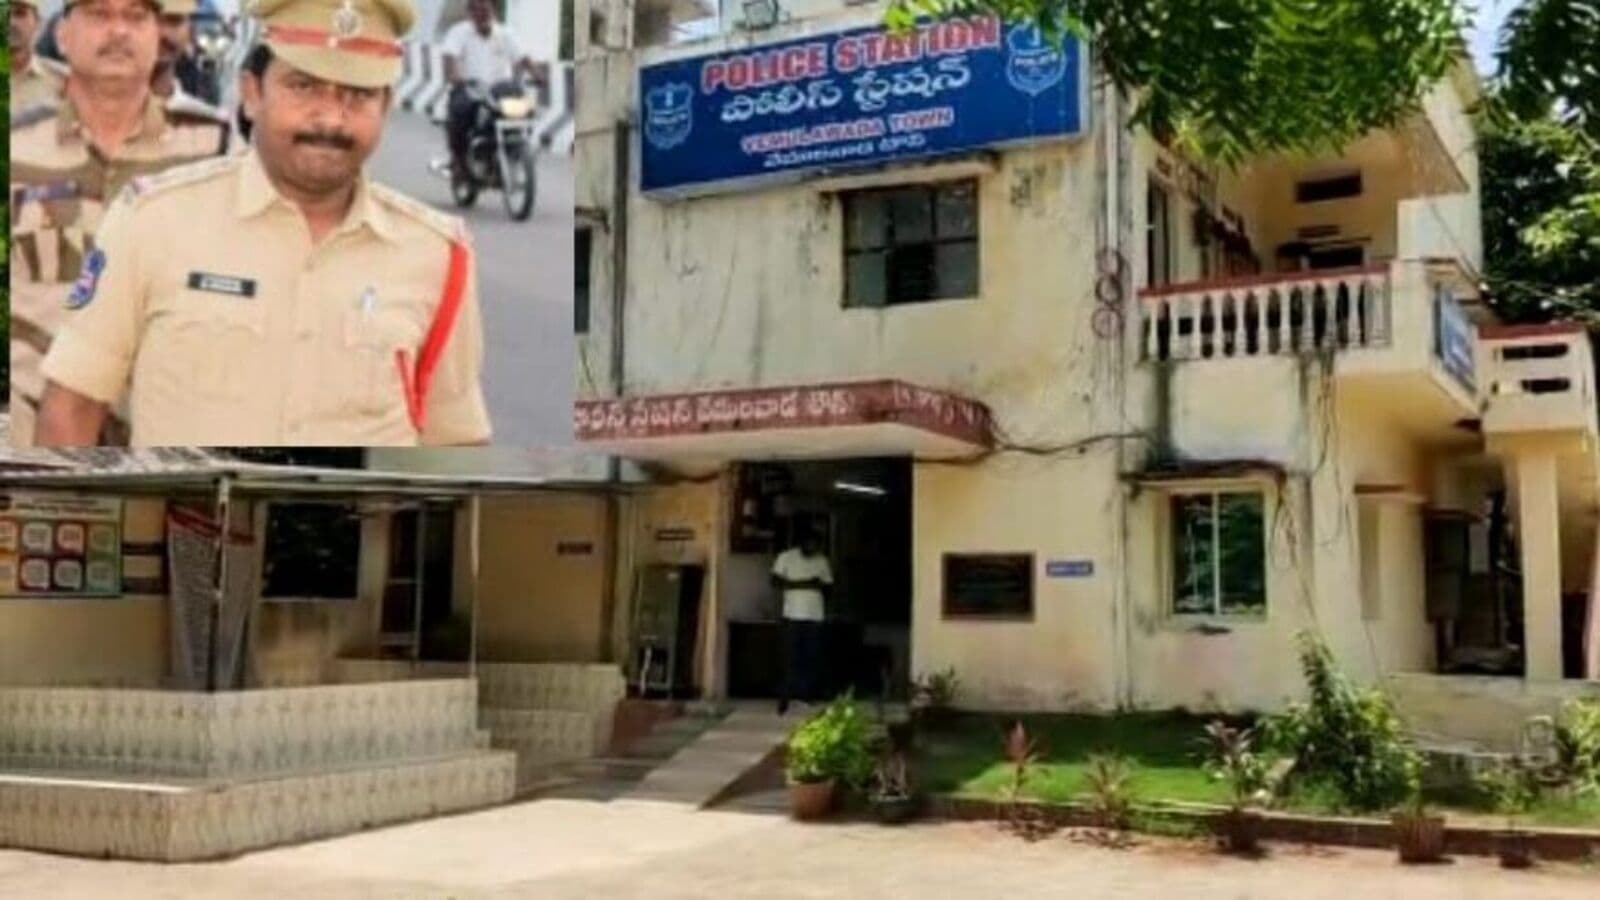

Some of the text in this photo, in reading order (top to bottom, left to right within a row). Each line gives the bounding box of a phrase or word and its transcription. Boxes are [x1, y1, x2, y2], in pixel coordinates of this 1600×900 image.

[702, 14, 1000, 94] POLICE STATION
[888, 106, 955, 133] TOWN
